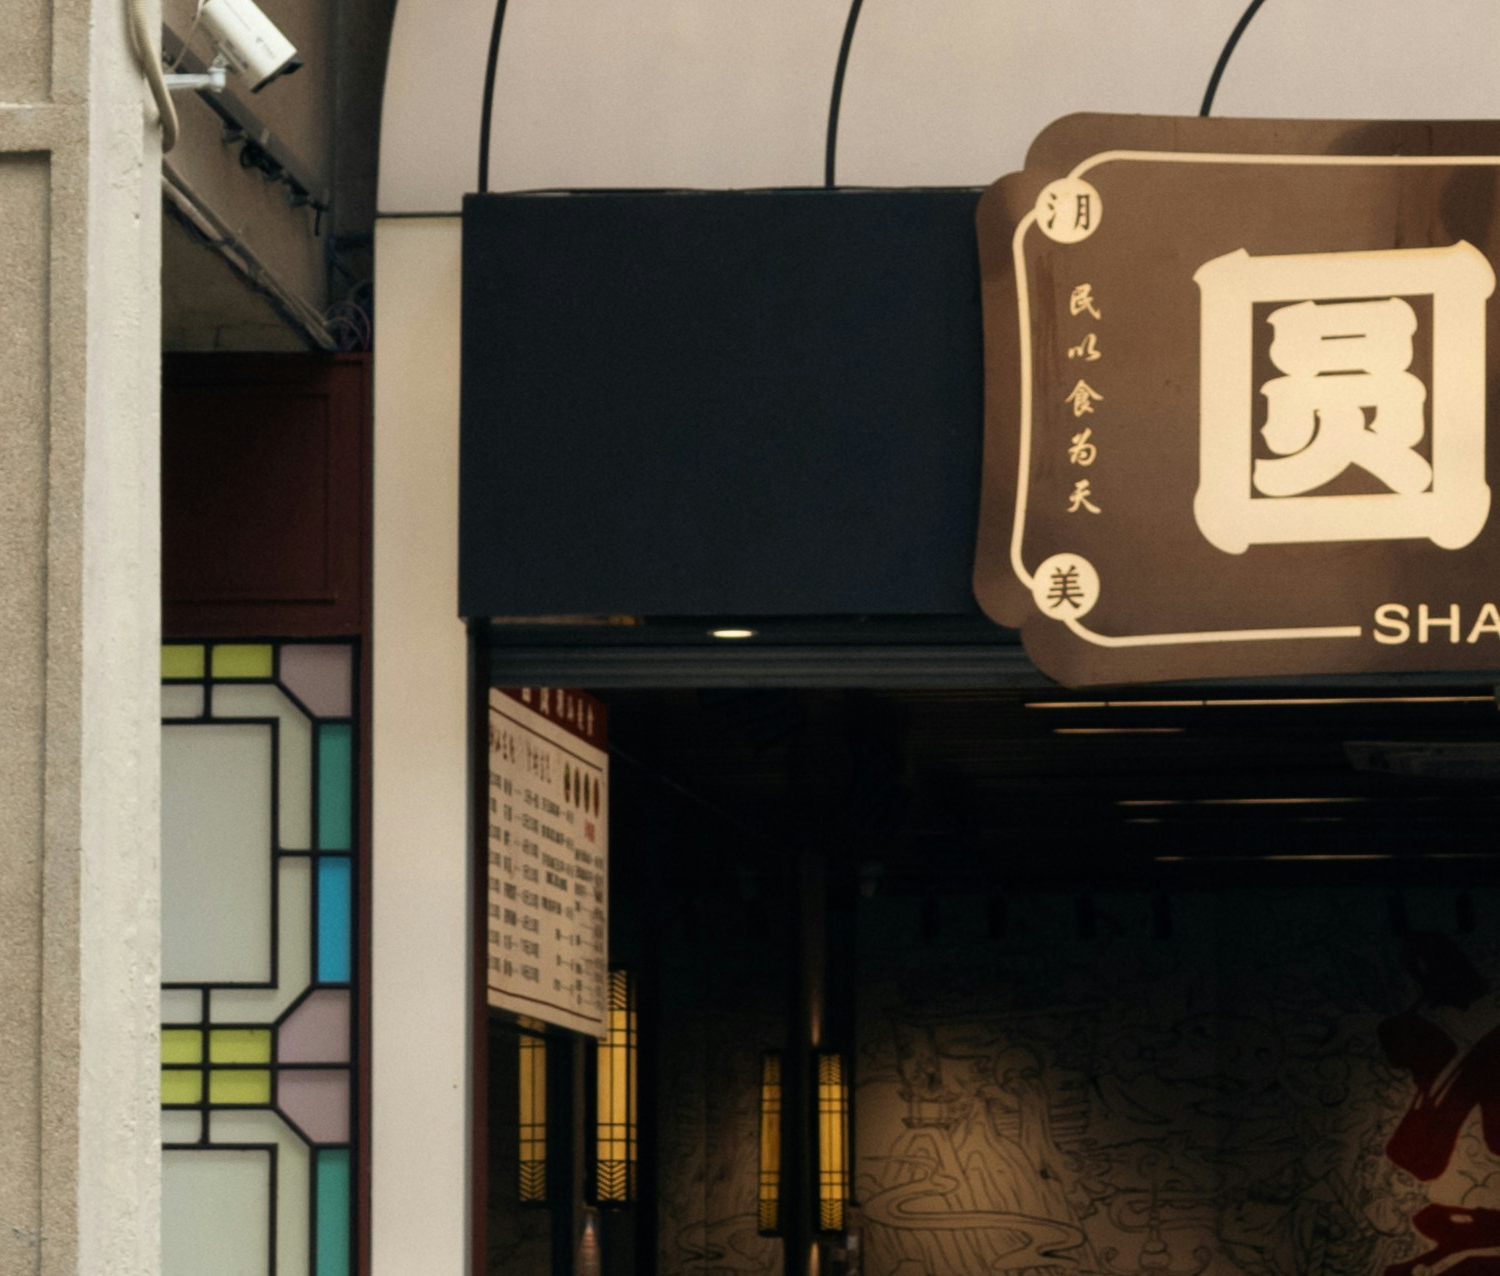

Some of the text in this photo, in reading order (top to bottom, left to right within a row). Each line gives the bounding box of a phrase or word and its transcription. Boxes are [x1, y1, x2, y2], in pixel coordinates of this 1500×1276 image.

[1065, 282, 1104, 515] 民以食为天
[1047, 563, 1086, 609] 美
